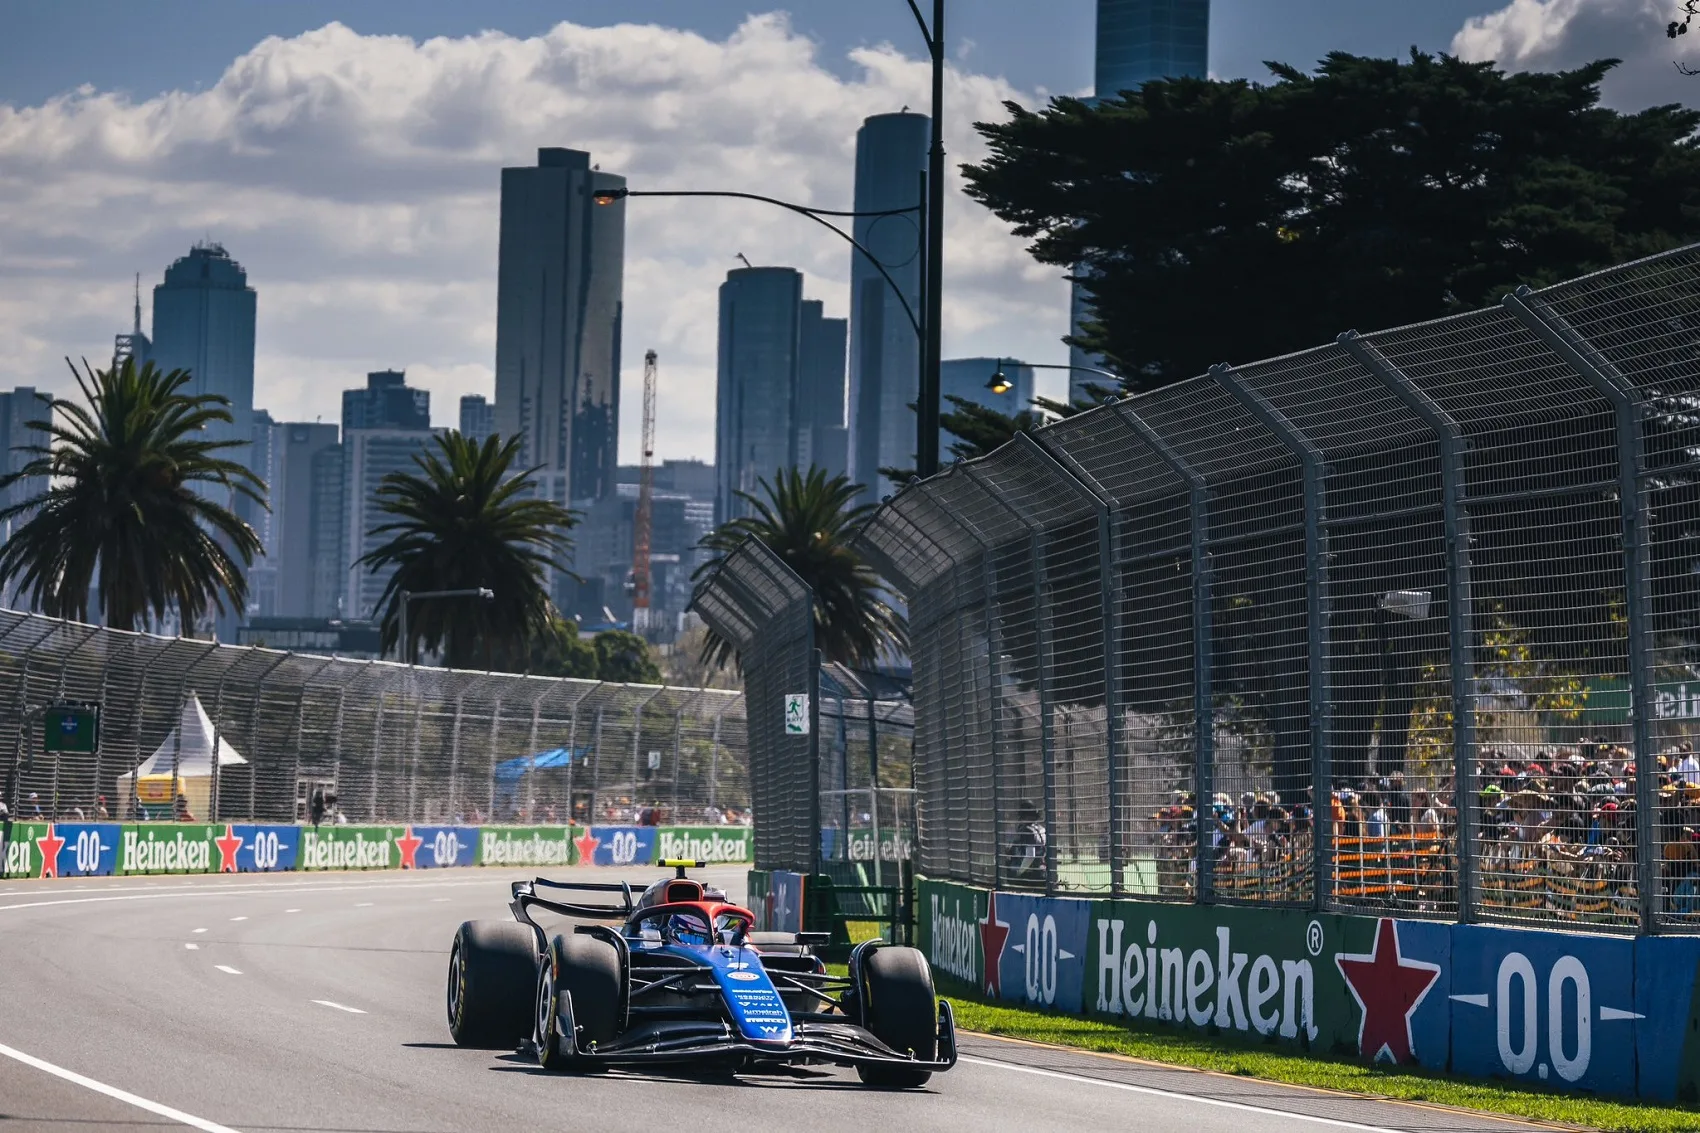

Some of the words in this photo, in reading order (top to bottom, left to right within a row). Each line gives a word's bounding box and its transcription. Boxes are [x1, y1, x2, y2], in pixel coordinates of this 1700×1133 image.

[123, 831, 210, 870] Heineken
[303, 832, 390, 867] Heineken
[482, 831, 568, 865] Heineken
[660, 832, 747, 861] Heineken
[931, 894, 977, 982] Heineken
[1025, 912, 1057, 1004] 0.0
[1496, 950, 1592, 1083] 0.0
